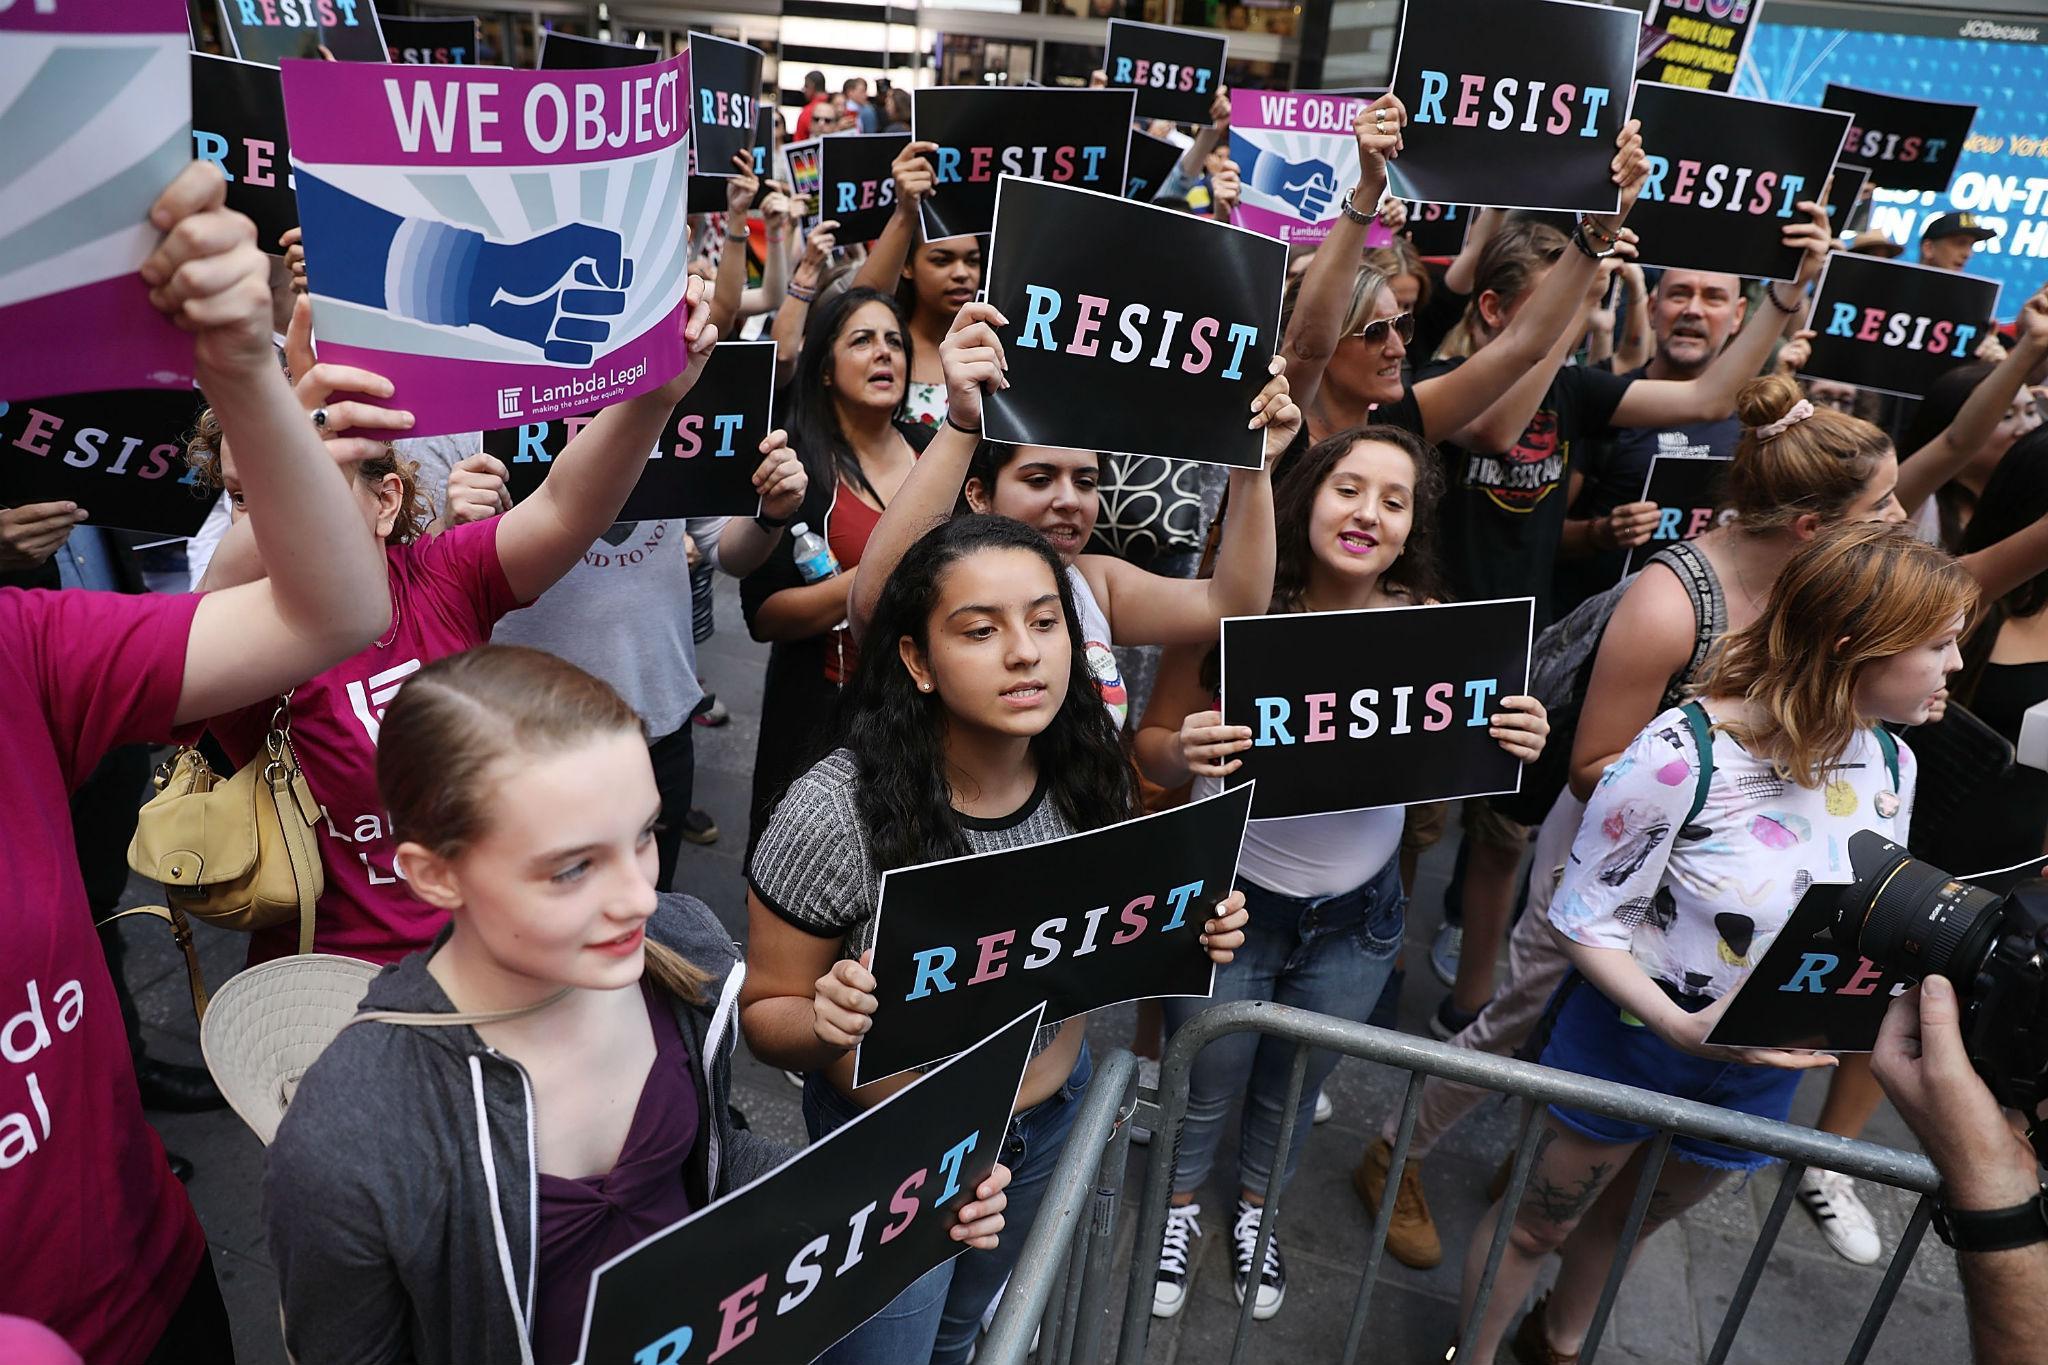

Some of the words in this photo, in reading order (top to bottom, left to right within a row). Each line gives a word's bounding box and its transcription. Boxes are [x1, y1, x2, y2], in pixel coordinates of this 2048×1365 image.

[238, 0, 360, 26] RESIST
[1959, 20, 2040, 41] JCDecaux
[1115, 57, 1211, 94] RESIST
[384, 79, 503, 153] WE
[523, 69, 679, 154] OBJECT
[700, 88, 760, 129] RESI
[1260, 95, 1298, 126] WE
[1414, 70, 1609, 138] RESIST
[192, 129, 297, 191] RE
[936, 146, 1106, 183] RESIST
[836, 177, 899, 213] RES
[1639, 154, 1804, 218] RESIST
[1017, 285, 1257, 381] RESIST
[1826, 302, 1976, 358] RESIST
[531, 372, 606, 404] Lambda
[610, 357, 648, 386] Legal
[532, 404, 560, 415] making
[560, 400, 573, 409] the
[574, 397, 589, 406] case
[590, 394, 601, 403] for
[601, 387, 625, 400] equality
[0, 400, 200, 486] ESIS
[615, 549, 643, 568] TO
[1255, 680, 1498, 748] RESIST
[321, 805, 394, 842] La
[906, 880, 1204, 1001] RESIST
